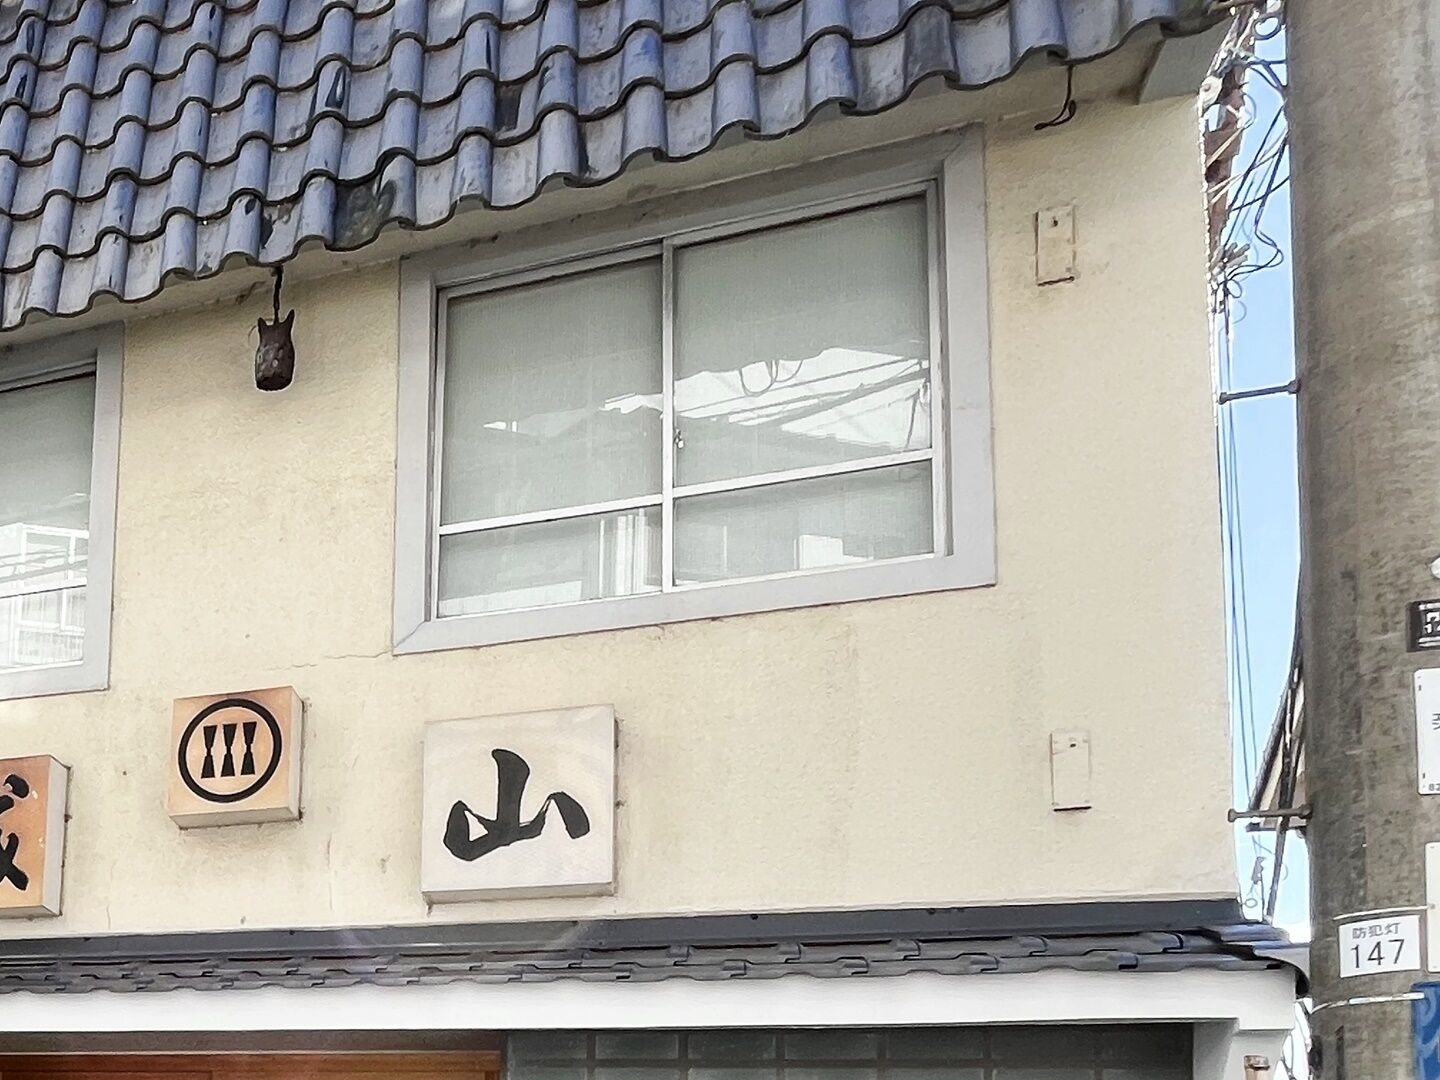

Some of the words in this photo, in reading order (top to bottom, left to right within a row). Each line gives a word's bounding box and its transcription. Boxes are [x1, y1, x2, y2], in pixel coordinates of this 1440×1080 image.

[441, 747, 590, 862] 山
[1352, 922, 1400, 939] 防犯灯
[1350, 939, 1405, 969] 147
